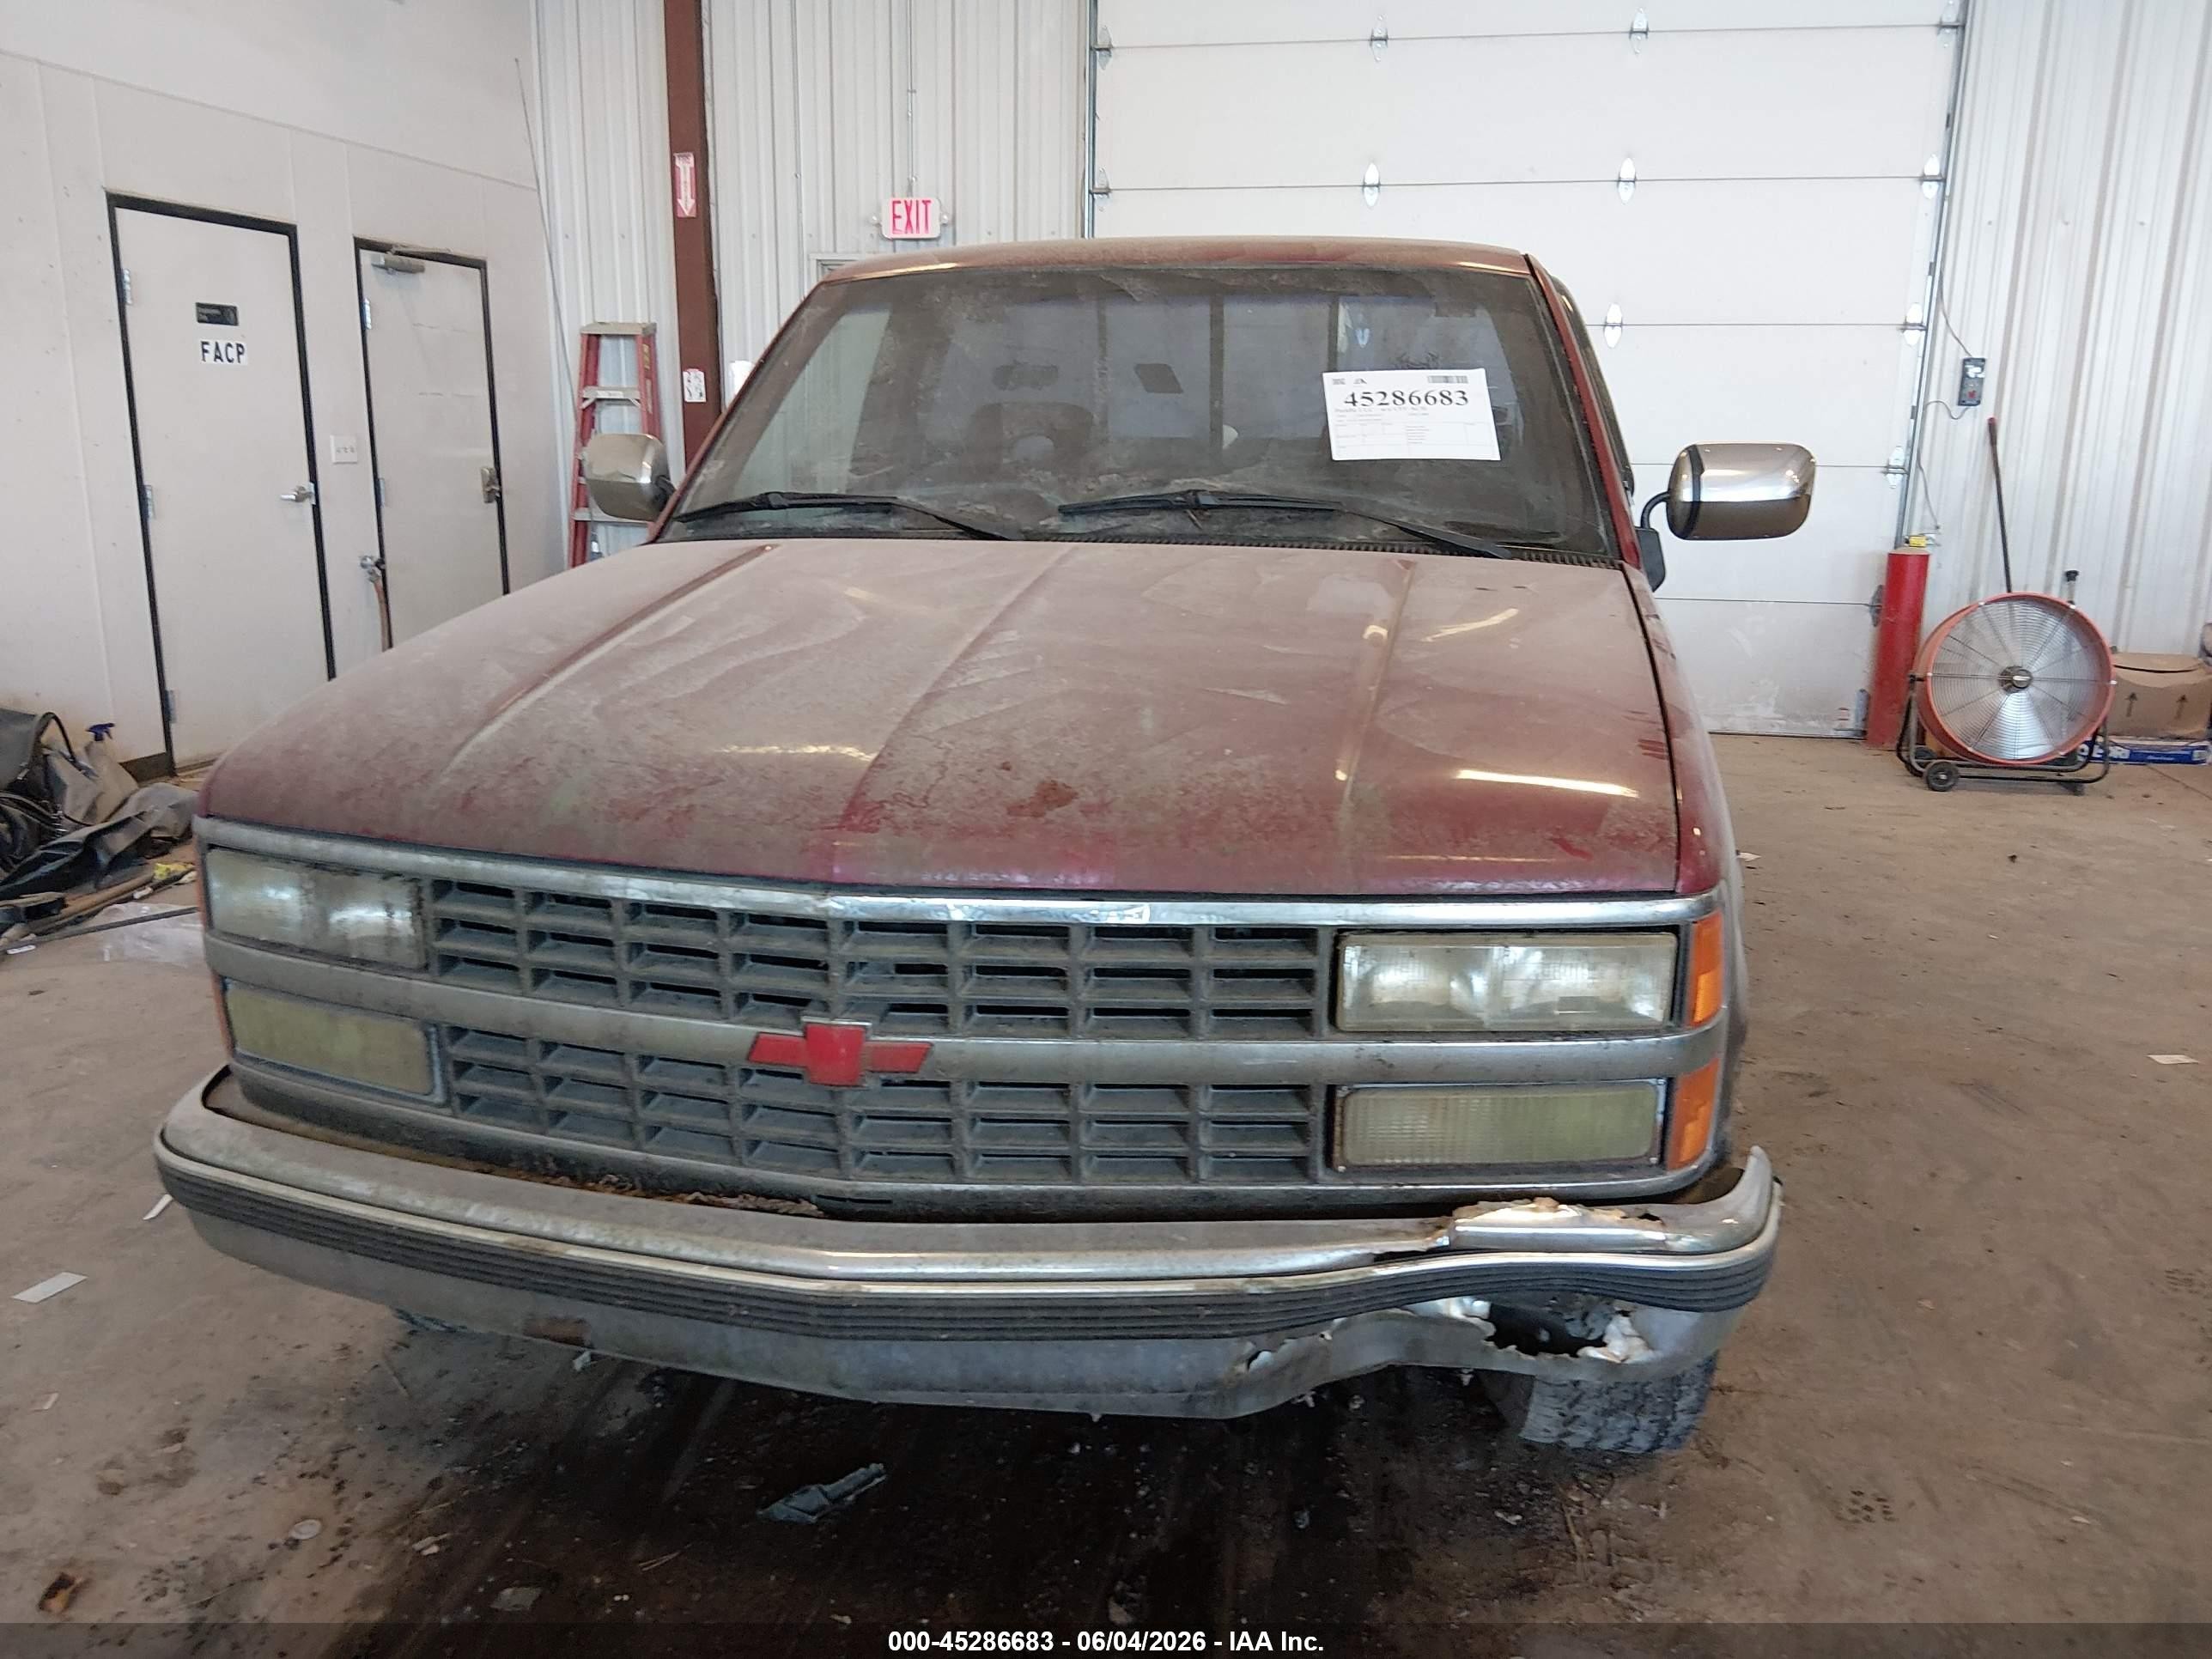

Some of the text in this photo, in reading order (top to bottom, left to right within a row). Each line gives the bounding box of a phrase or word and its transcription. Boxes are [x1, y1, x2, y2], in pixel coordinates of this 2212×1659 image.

[892, 199, 932, 234] EXIT
[200, 341, 245, 363] FACP
[1344, 390, 1469, 407] 45286683
